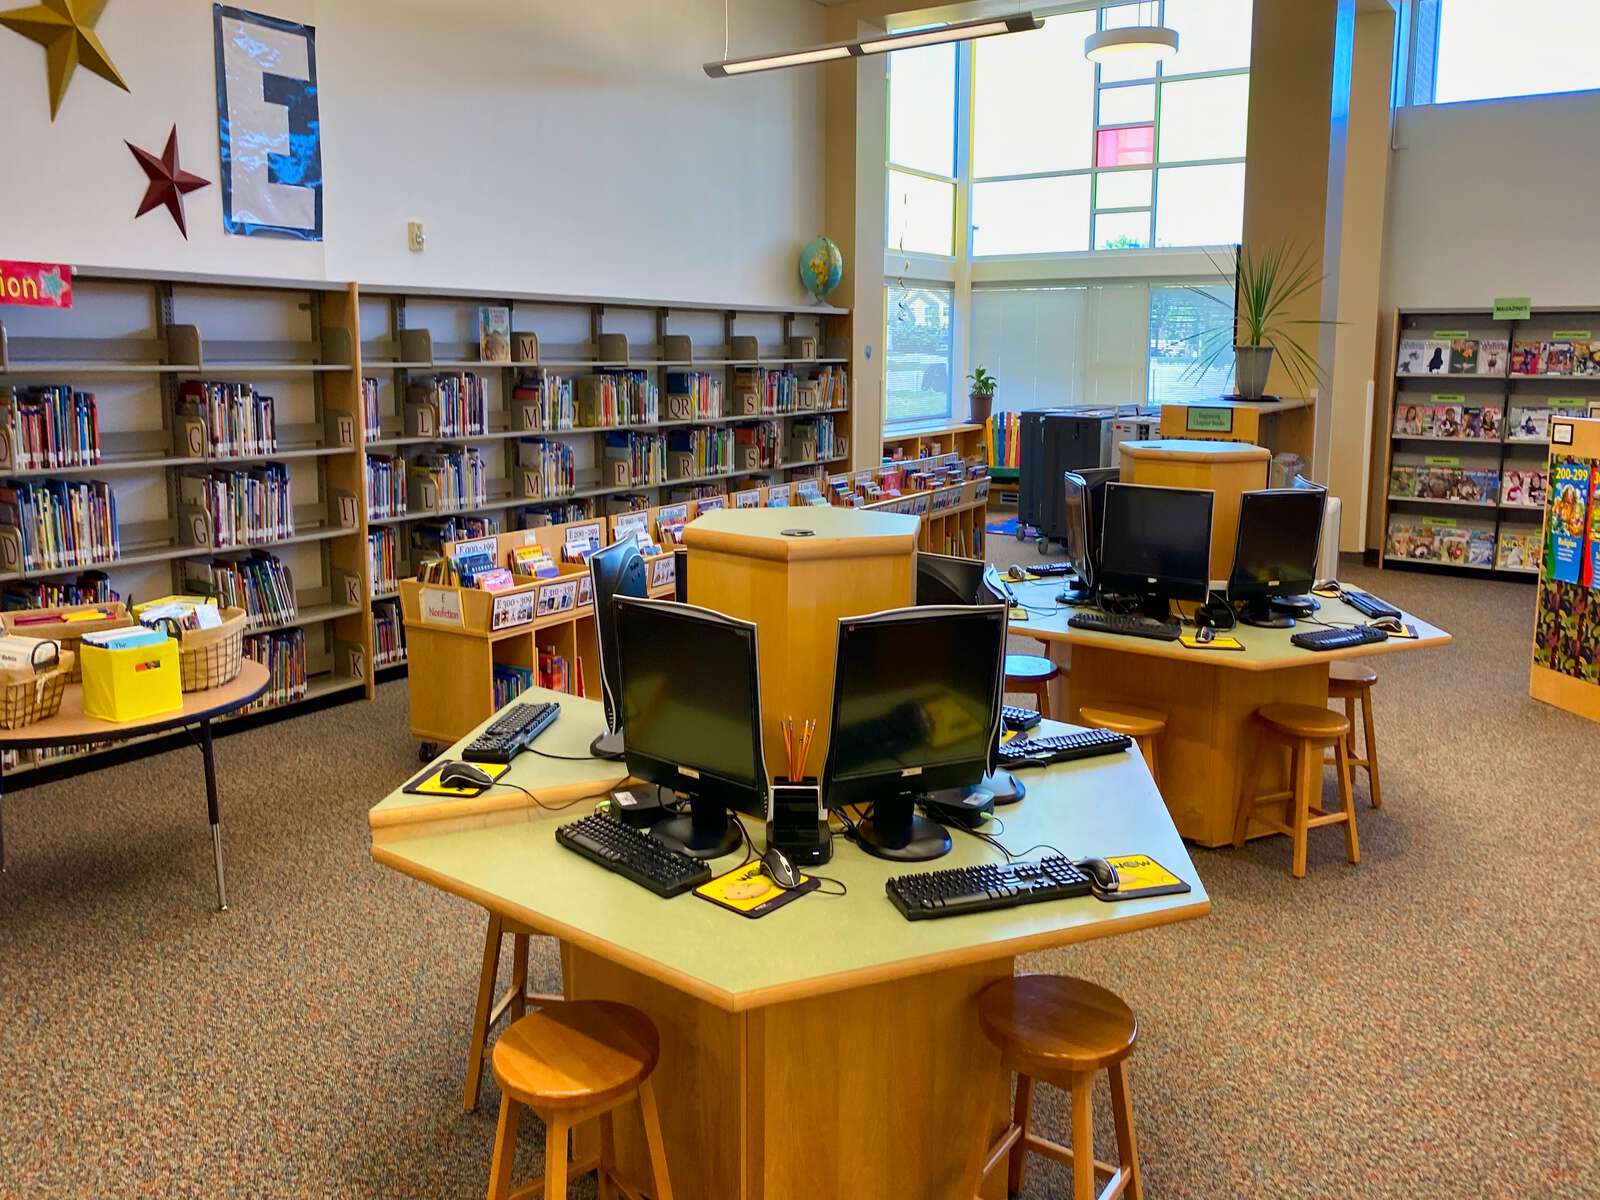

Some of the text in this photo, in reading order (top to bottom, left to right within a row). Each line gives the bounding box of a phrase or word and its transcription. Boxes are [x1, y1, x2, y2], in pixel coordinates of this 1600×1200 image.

[222, 16, 316, 230] E
[521, 339, 535, 360] M
[803, 341, 813, 358] T
[670, 397, 690, 418] QR
[746, 396, 755, 415] S
[420, 411, 430, 433] L
[524, 408, 538, 429] M
[189, 426, 202, 454] G
[341, 422, 353, 443] H
[748, 449, 757, 468] S
[803, 441, 814, 458] V
[617, 464, 626, 483] P
[681, 459, 691, 477] R
[1556, 467, 1588, 481] 200-299
[526, 471, 540, 495] M
[424, 487, 434, 509] L
[193, 518, 206, 545] G
[348, 581, 360, 602] K
[428, 605, 459, 620] Nonfiction
[503, 598, 515, 608] 300
[352, 653, 363, 678] K
